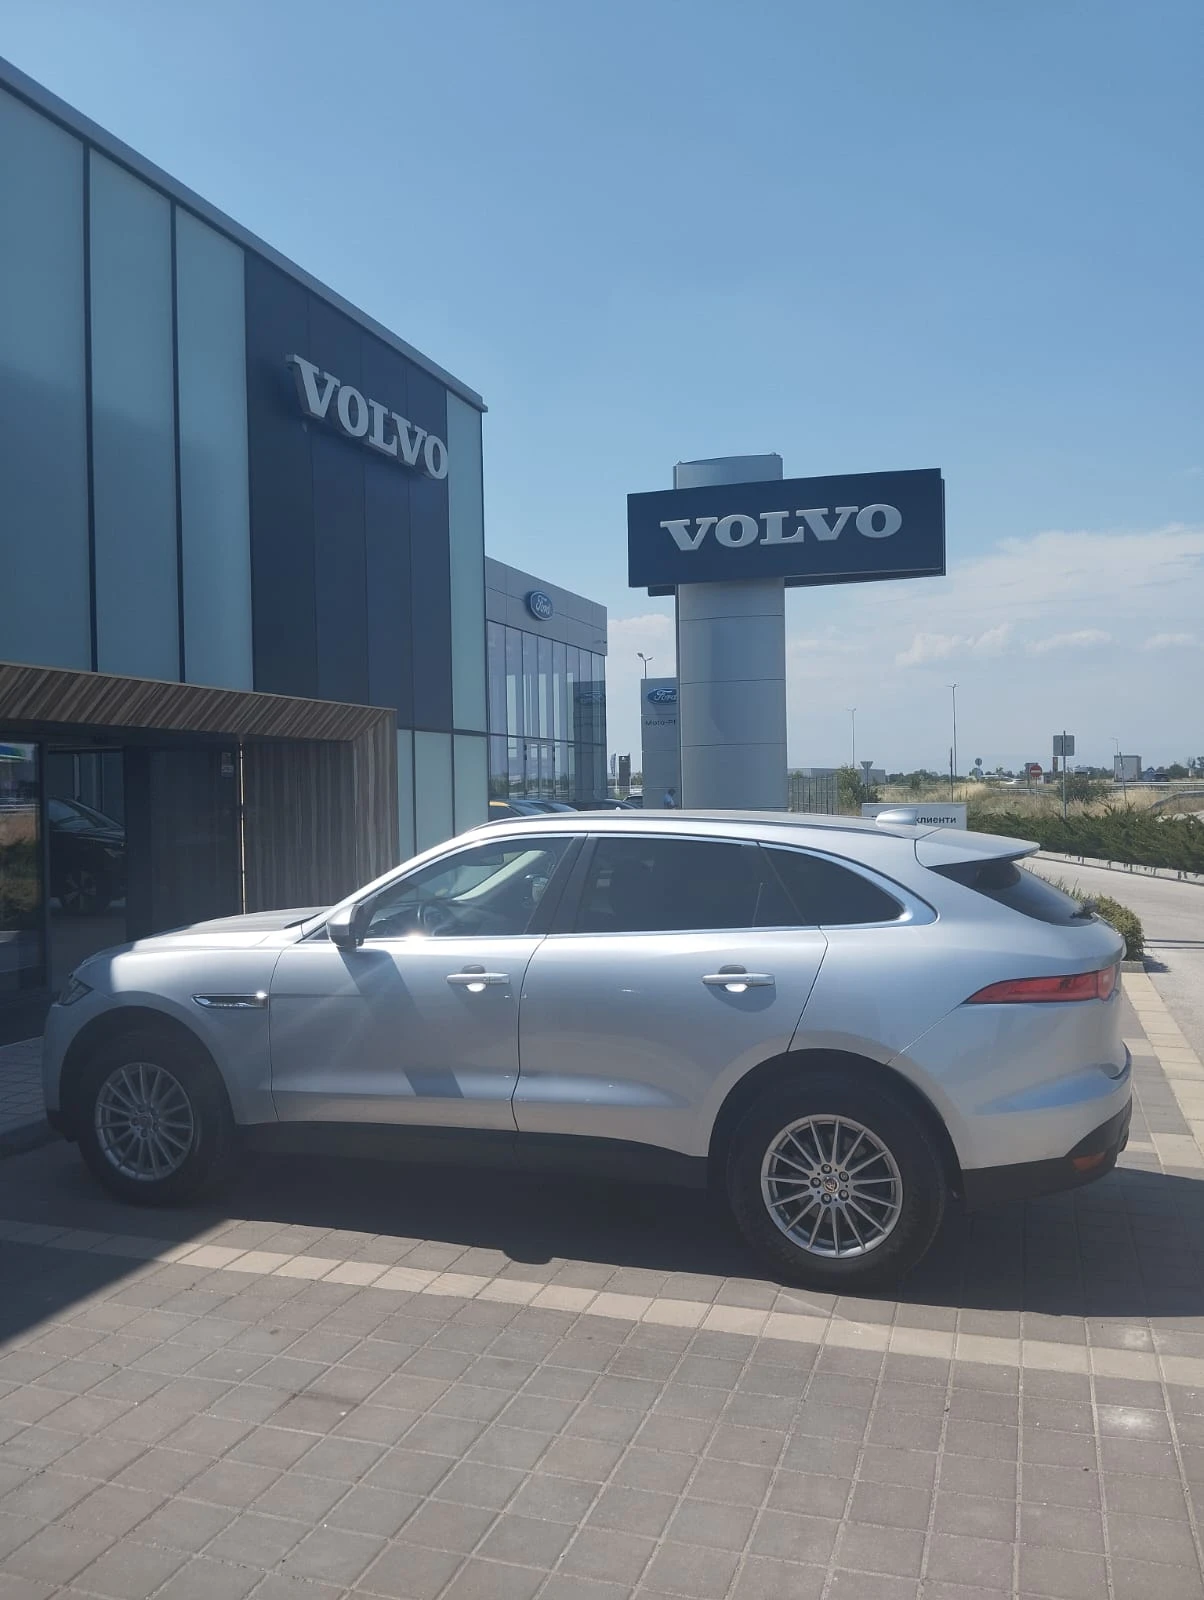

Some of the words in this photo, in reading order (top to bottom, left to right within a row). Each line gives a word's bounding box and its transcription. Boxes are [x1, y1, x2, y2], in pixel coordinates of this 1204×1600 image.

[293, 354, 448, 479] VOLVO
[659, 503, 902, 550] VOLVO
[534, 594, 551, 615] Ford
